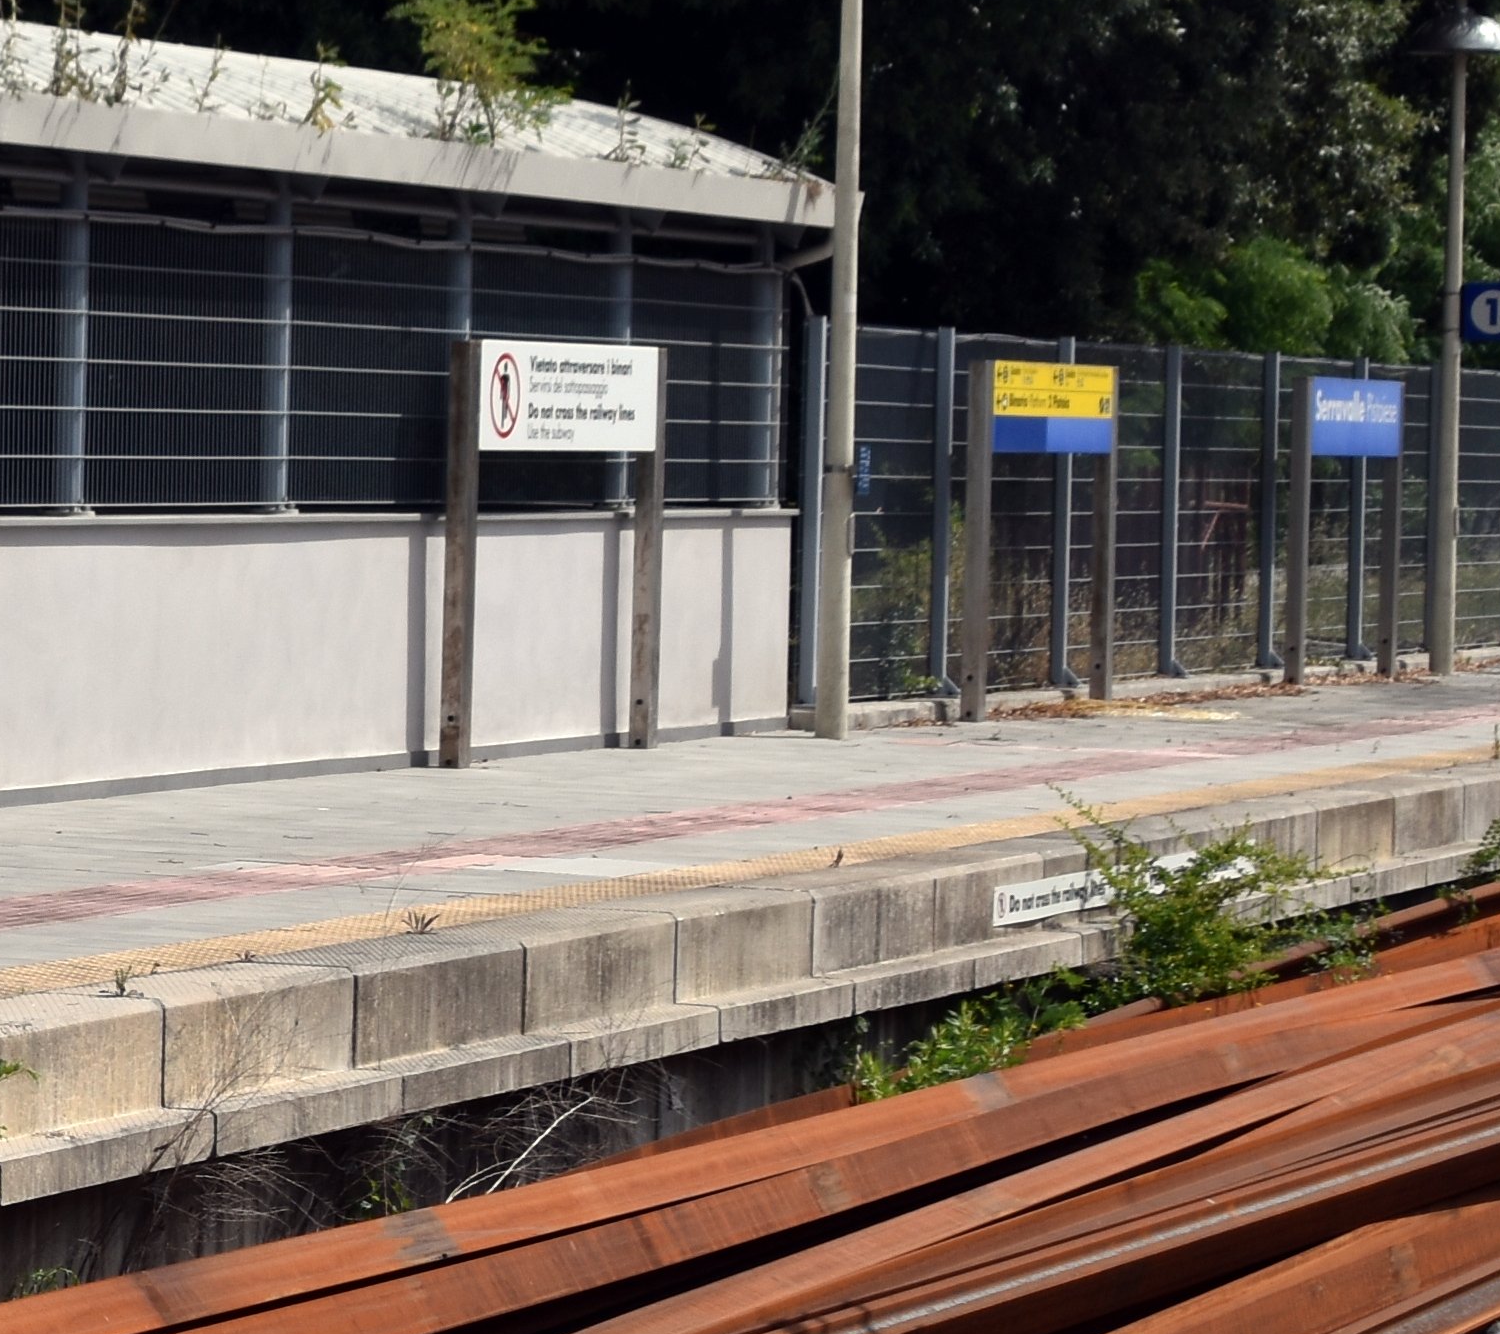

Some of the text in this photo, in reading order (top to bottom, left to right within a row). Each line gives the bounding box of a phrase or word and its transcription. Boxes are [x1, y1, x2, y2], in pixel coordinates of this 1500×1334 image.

[1485, 298, 1498, 326] 1
[528, 402, 635, 425] Do not cross the railway lines
